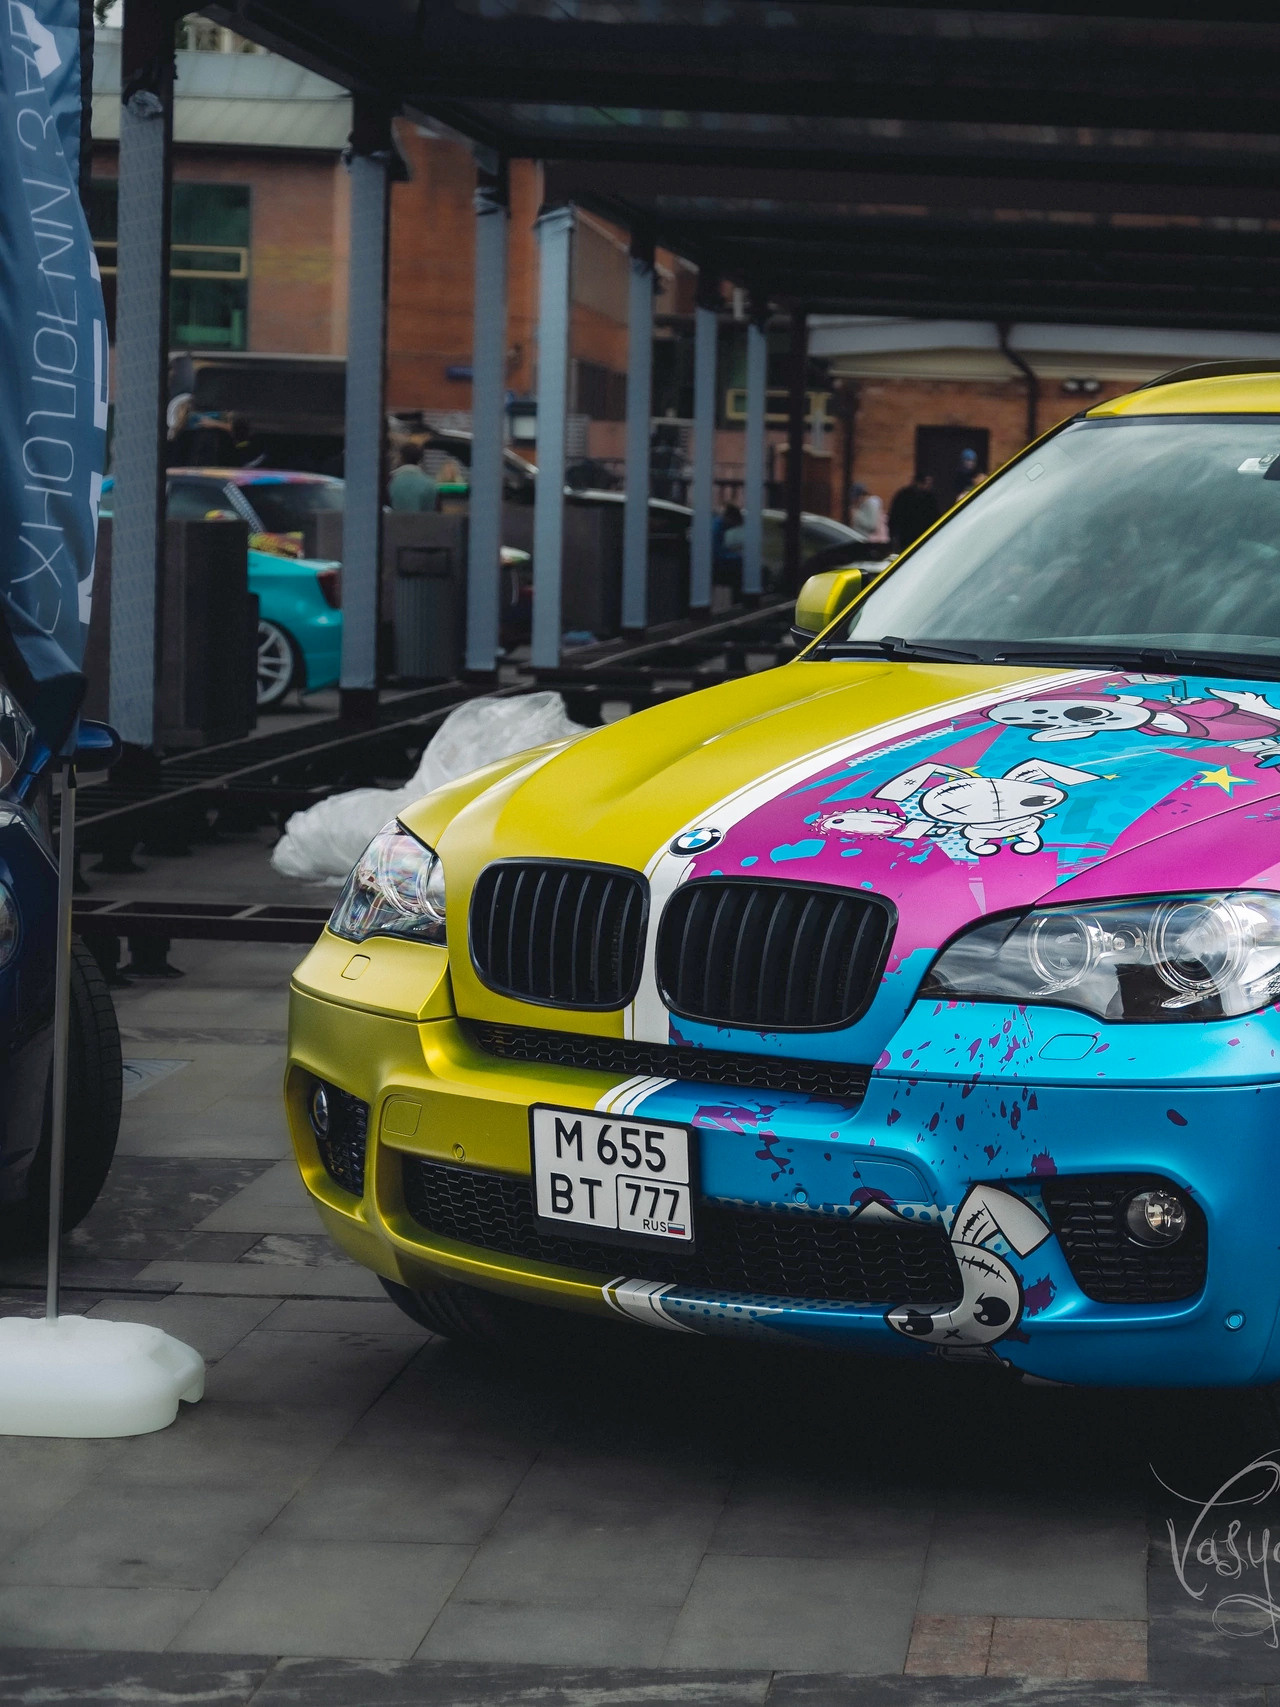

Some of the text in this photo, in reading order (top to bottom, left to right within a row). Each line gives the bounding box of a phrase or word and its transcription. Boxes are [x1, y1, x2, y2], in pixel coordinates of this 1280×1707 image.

[597, 1124, 666, 1173] 655
[625, 1182, 680, 1221] 777
[643, 1218, 667, 1233] RUS
